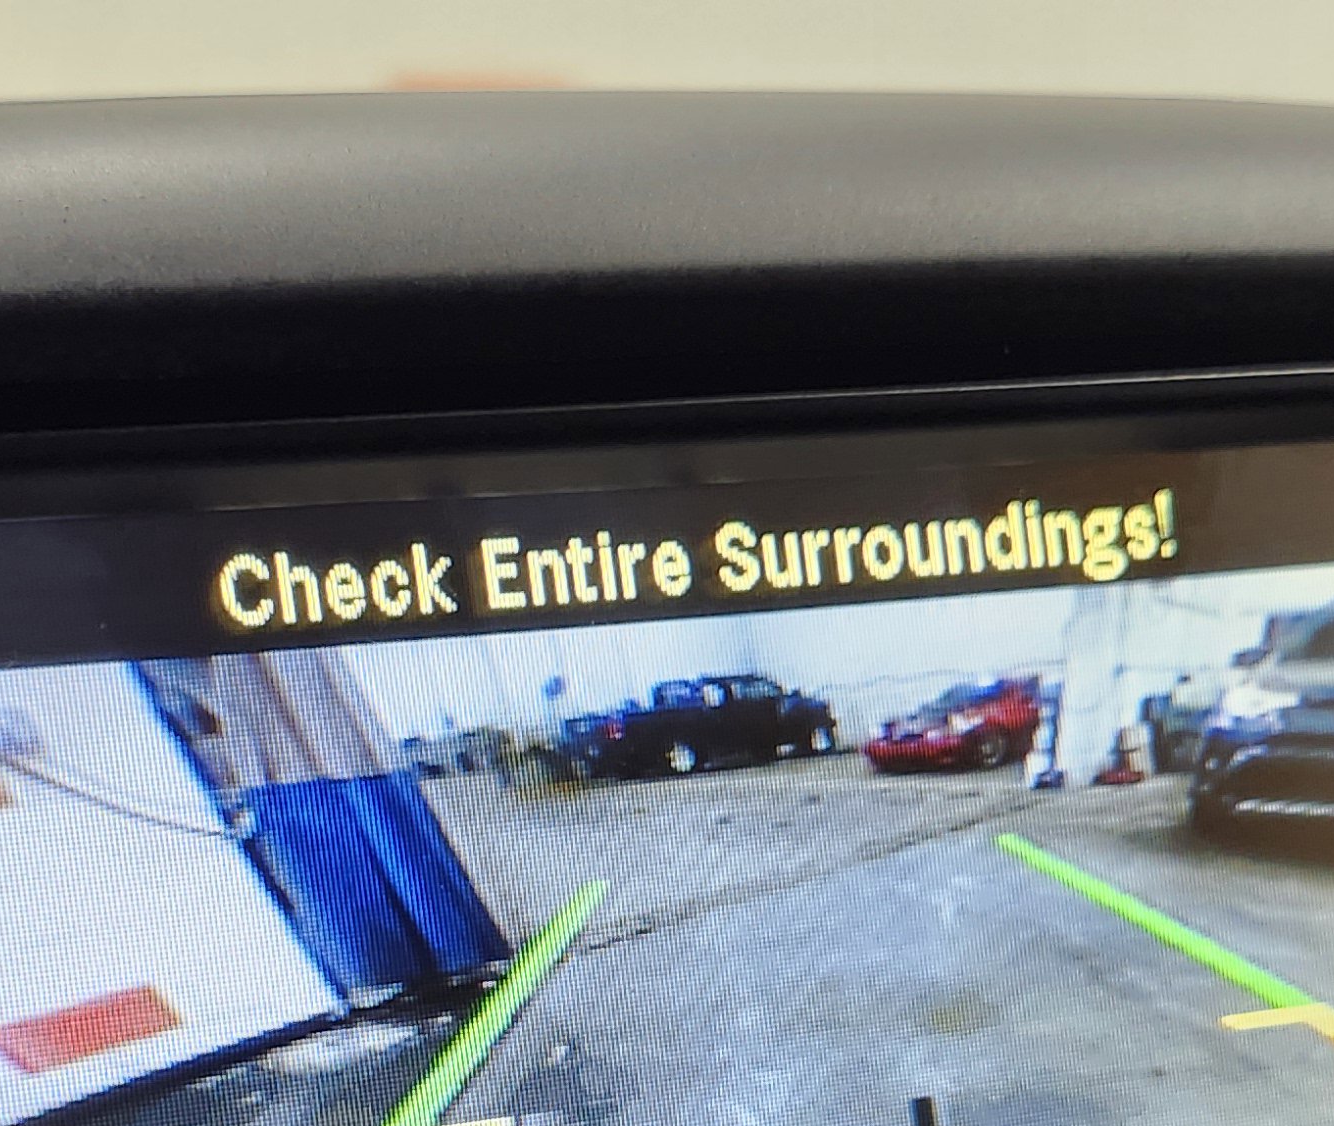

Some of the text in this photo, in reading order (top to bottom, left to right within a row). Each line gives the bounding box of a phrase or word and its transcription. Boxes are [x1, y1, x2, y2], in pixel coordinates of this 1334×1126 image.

[219, 489, 1175, 628] Check Entire Surroundings!
